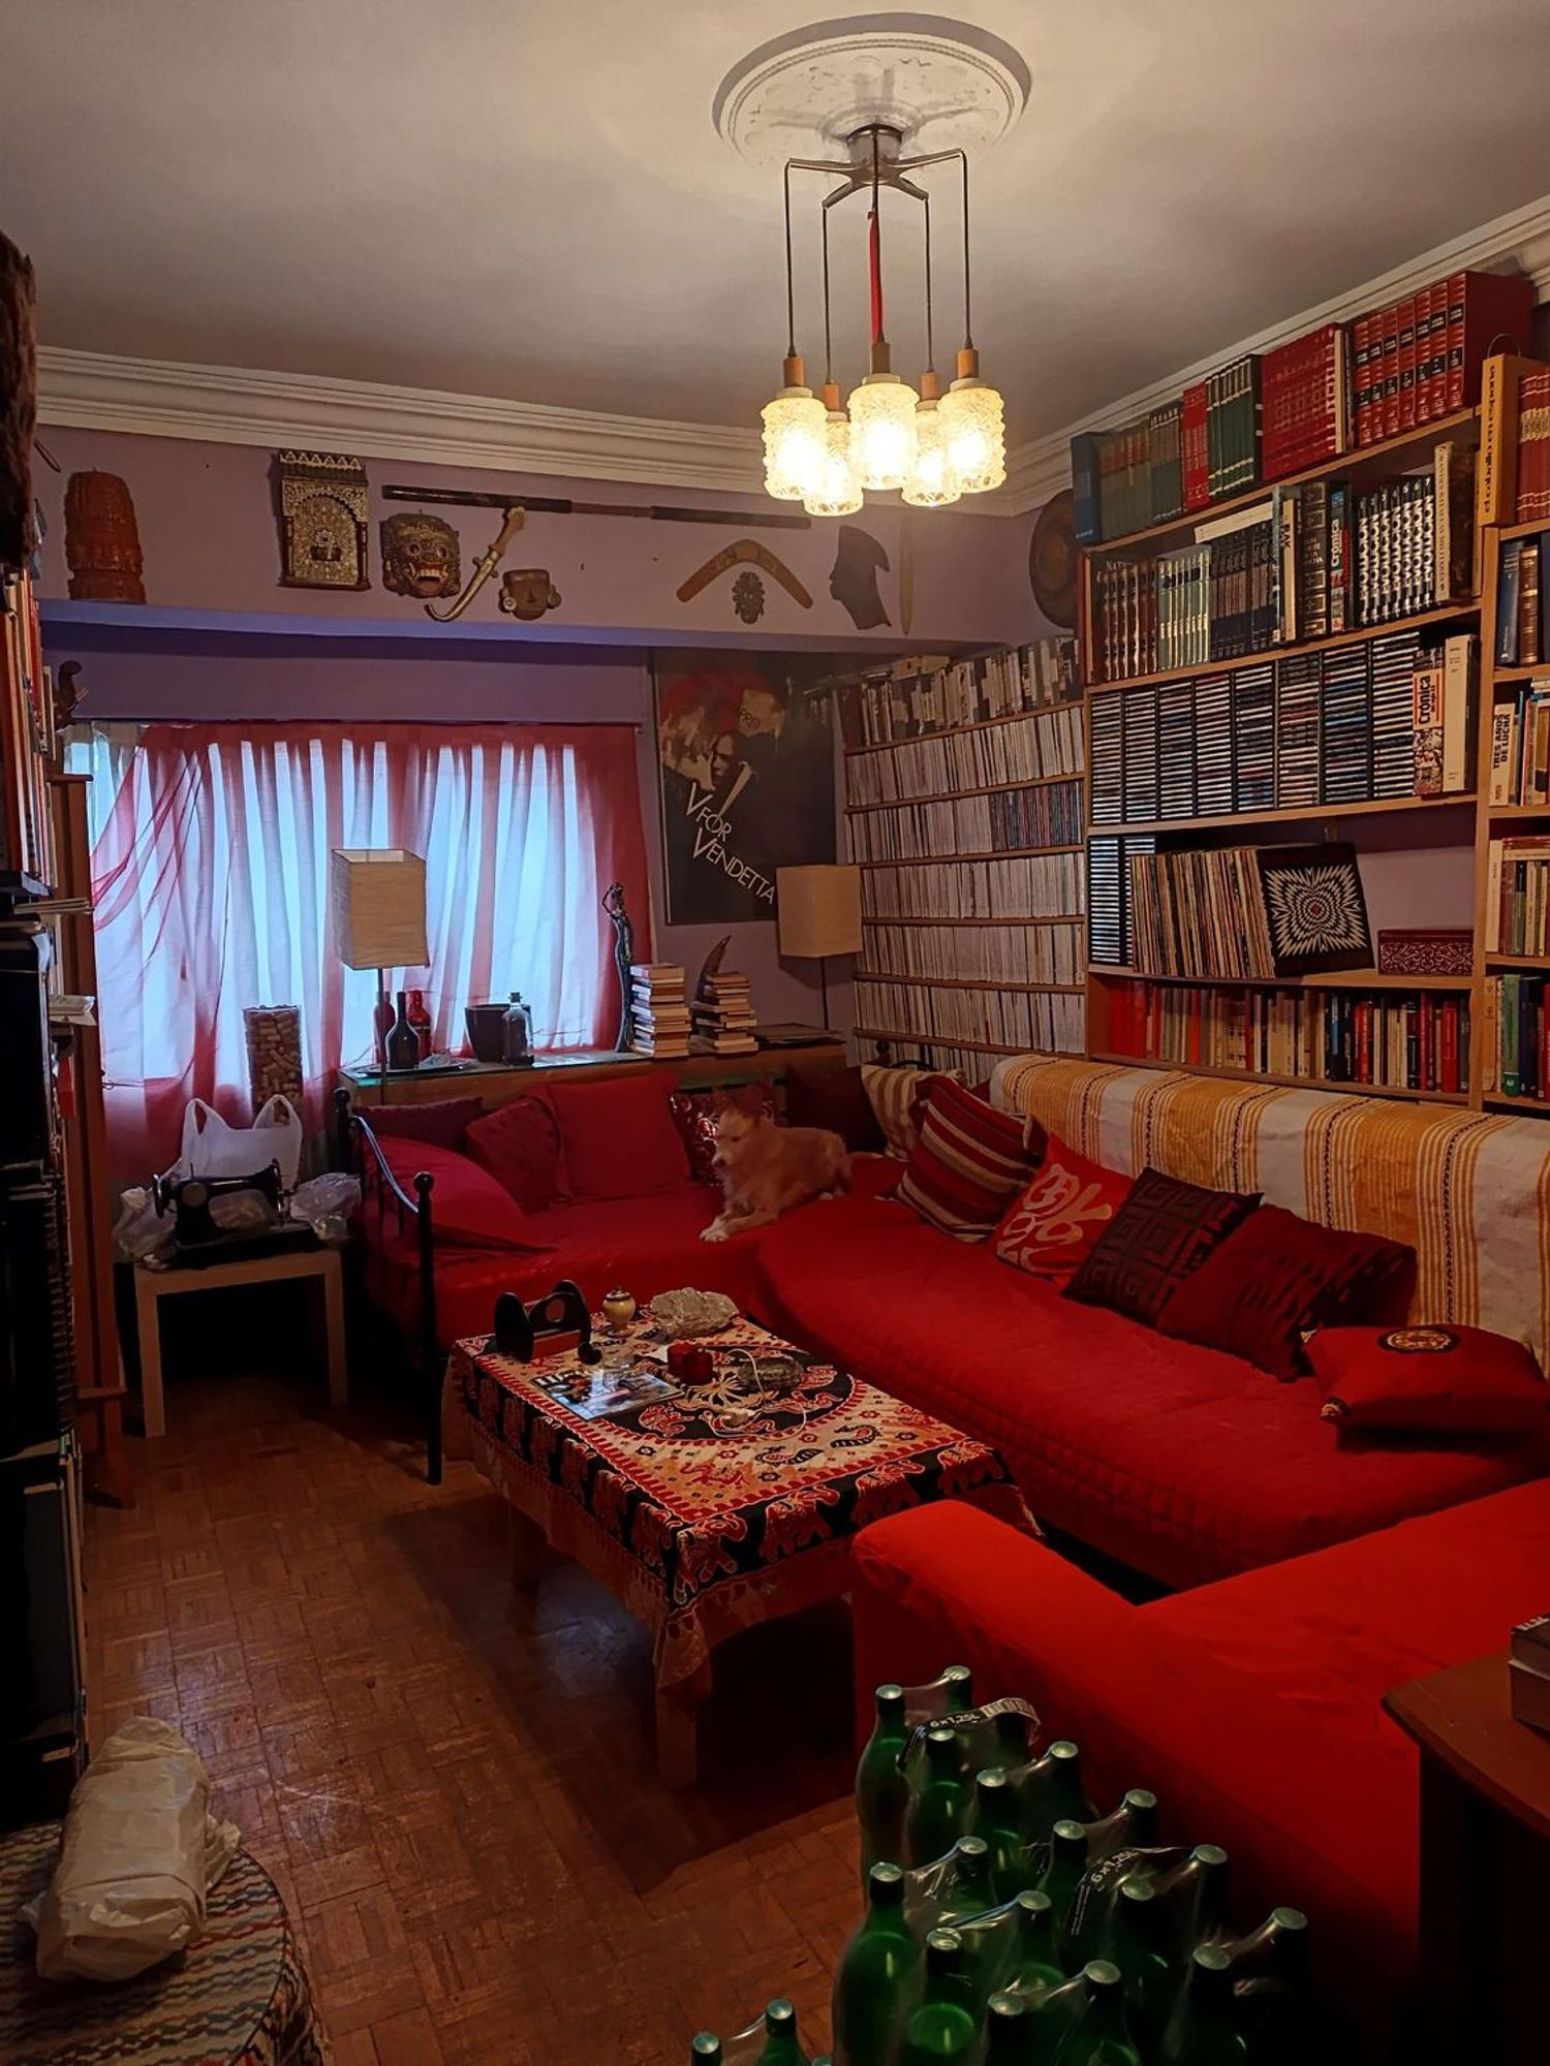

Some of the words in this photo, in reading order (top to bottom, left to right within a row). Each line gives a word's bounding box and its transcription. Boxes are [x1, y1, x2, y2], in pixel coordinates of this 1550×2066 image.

[1417, 675, 1431, 724] Crónica
[1502, 714, 1511, 746] LUCHA
[1493, 743, 1502, 769] TRES
[1500, 748, 1508, 762] DE
[686, 782, 713, 816] V
[696, 806, 732, 842] FOR
[693, 827, 776, 905] VENDETTA
